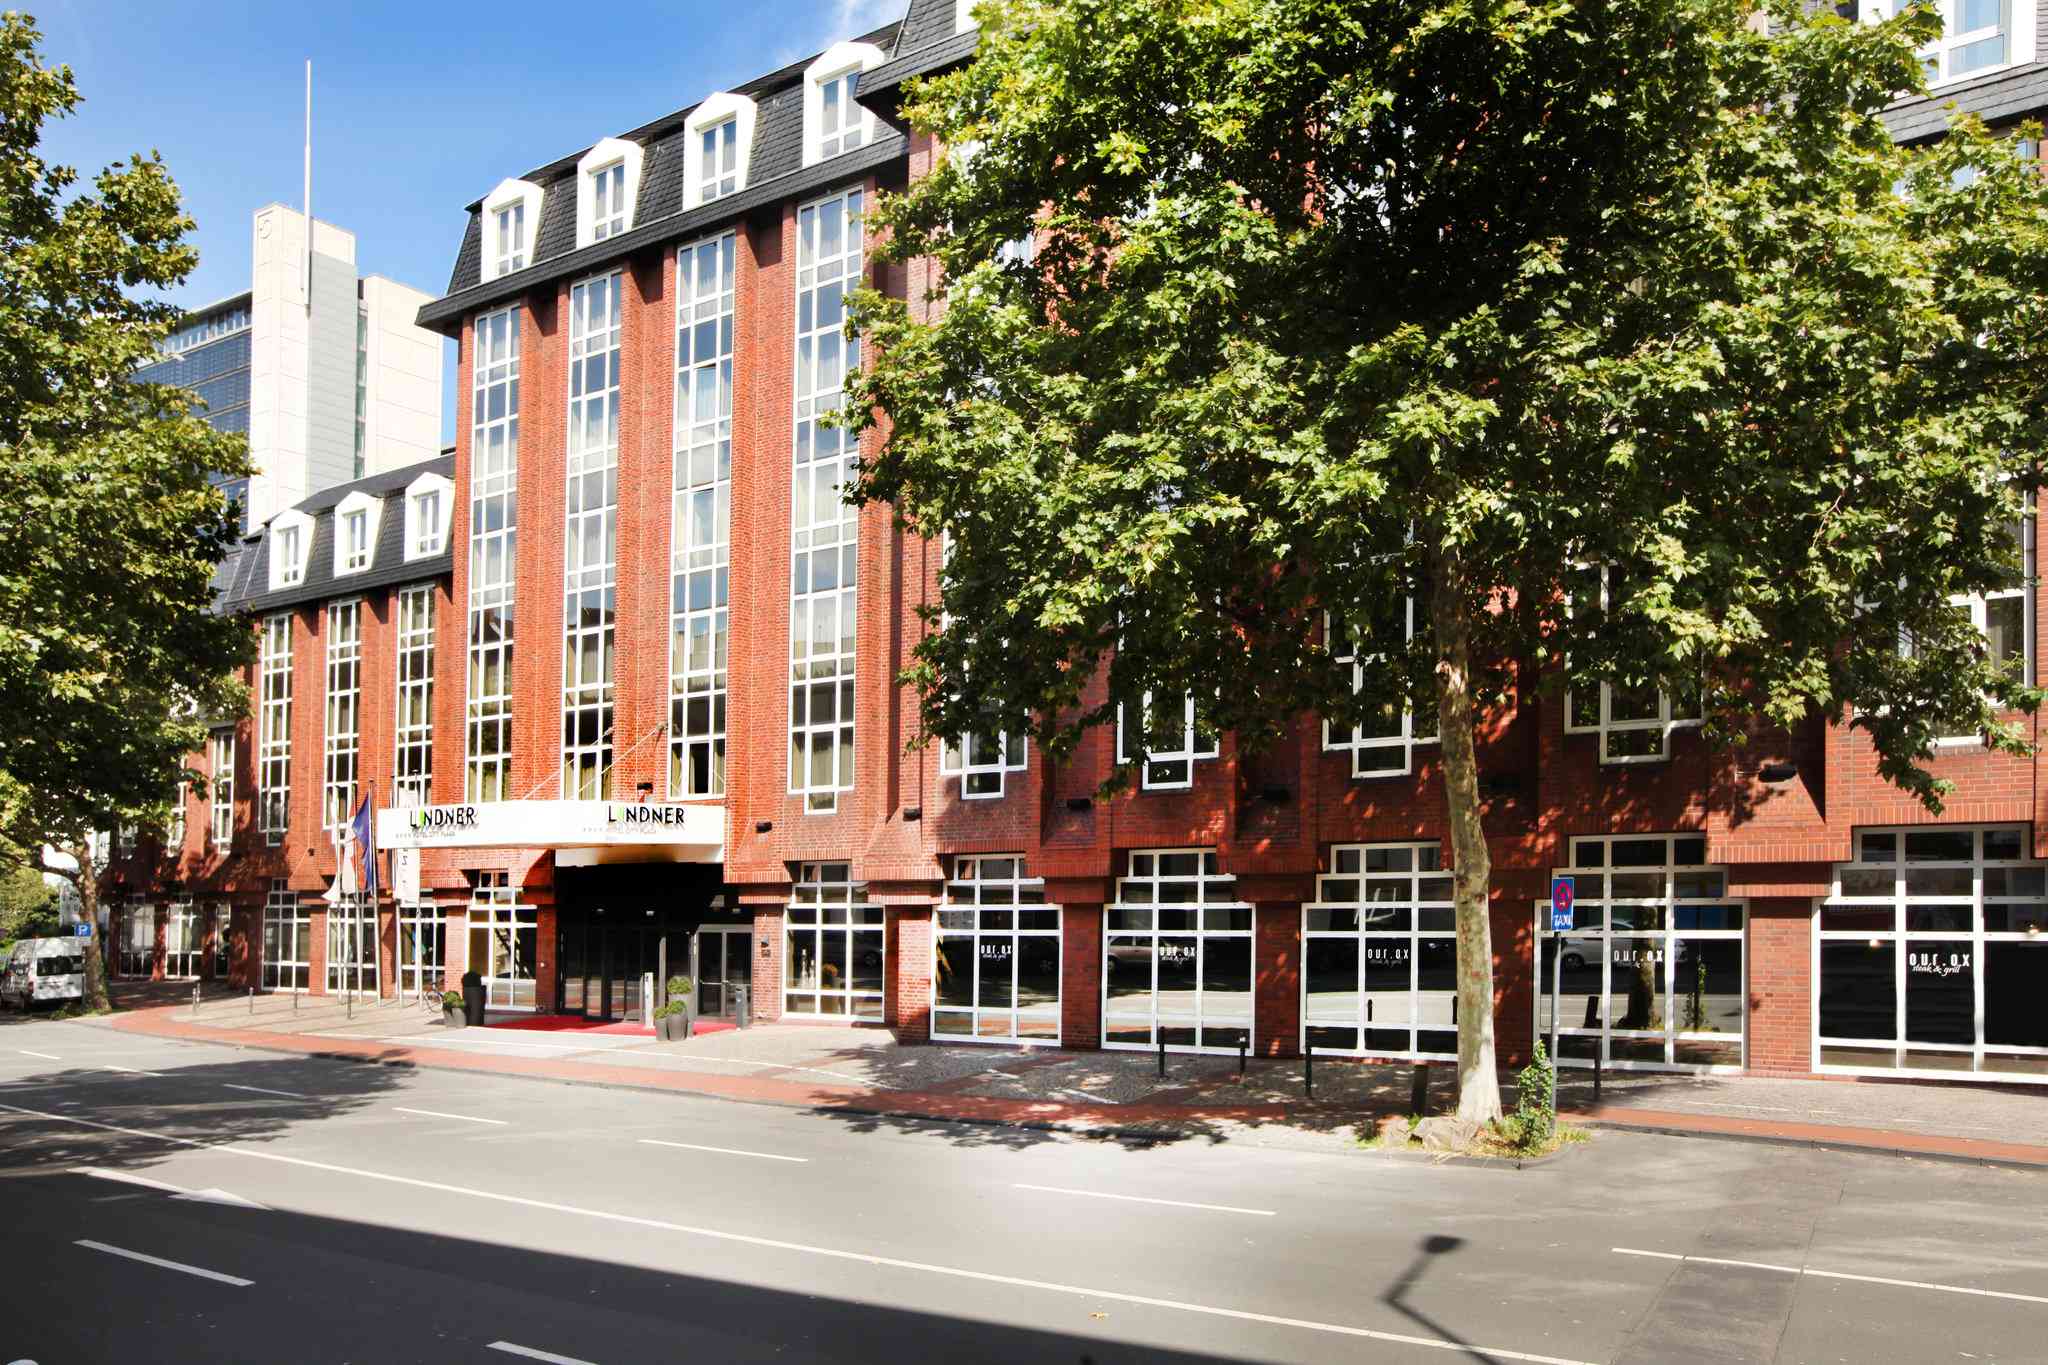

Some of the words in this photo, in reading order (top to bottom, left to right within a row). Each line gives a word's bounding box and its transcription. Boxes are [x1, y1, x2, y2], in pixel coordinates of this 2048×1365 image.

[410, 807, 476, 828] LINDNER
[608, 805, 685, 824] LINDNER
[1553, 914, 1572, 927] TAXI
[78, 925, 88, 935] P
[1941, 964, 1962, 977] grill
